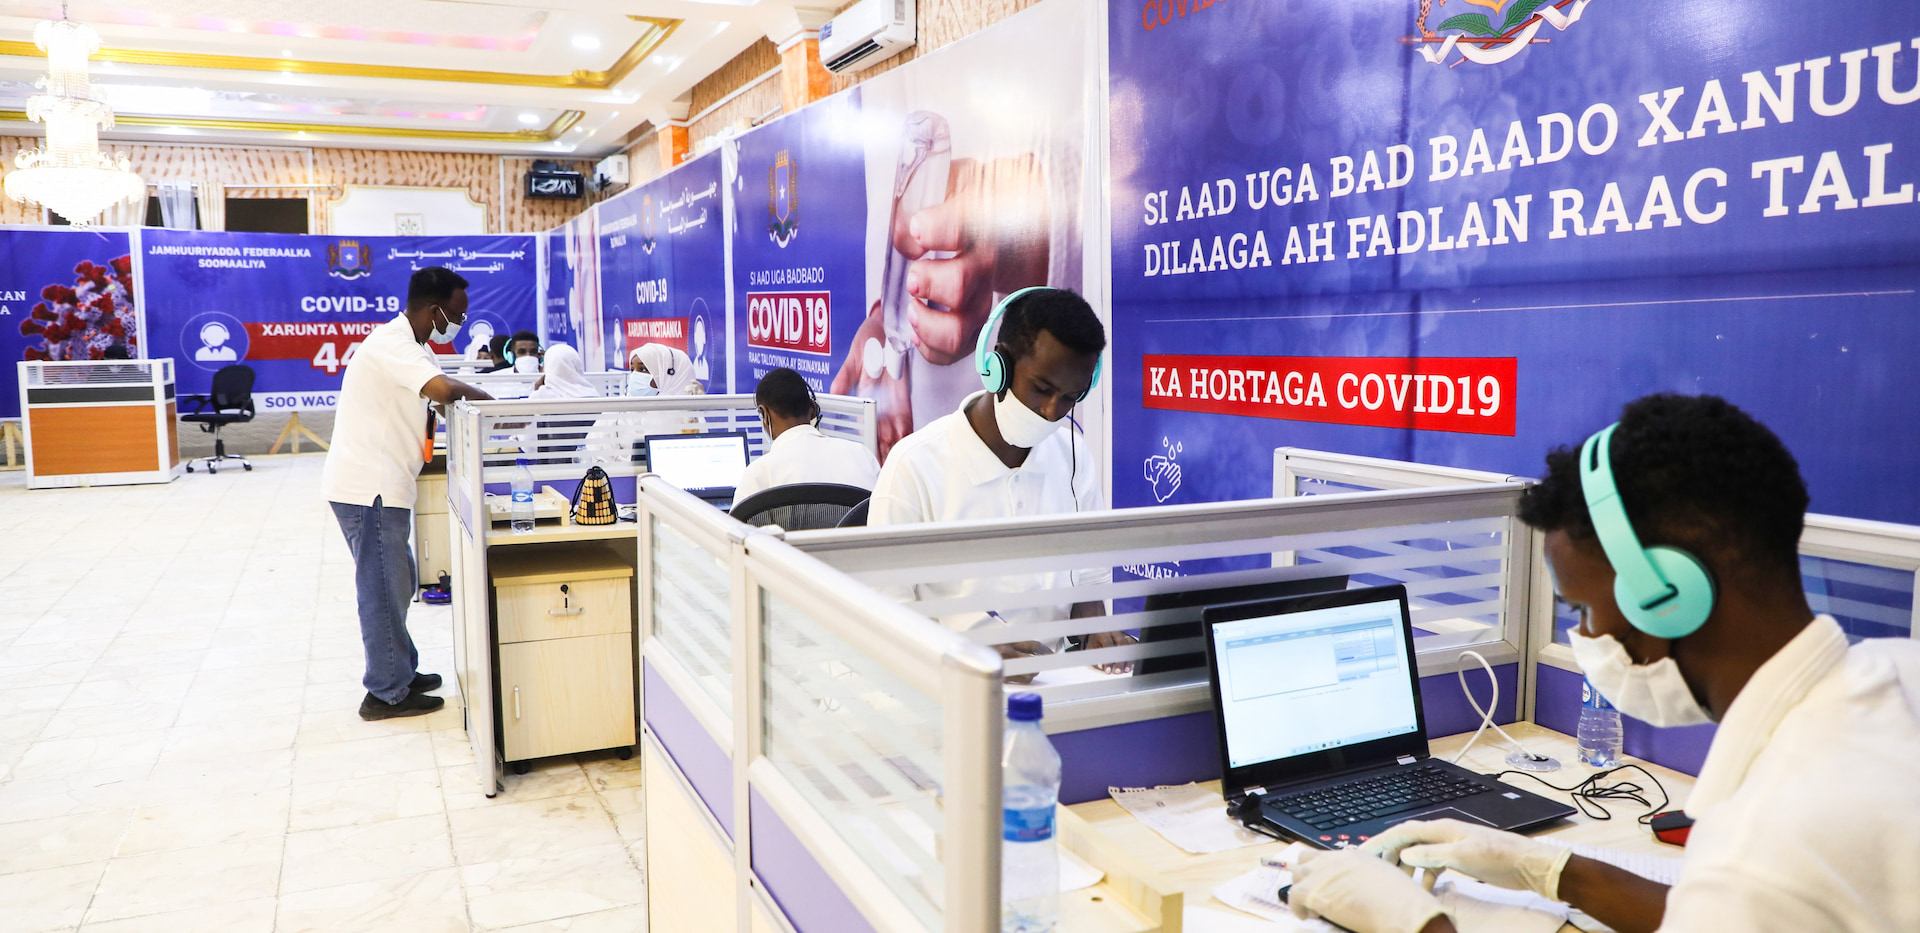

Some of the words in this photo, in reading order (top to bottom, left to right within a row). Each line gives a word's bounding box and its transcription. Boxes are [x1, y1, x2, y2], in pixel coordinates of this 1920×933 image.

[1143, 189, 1169, 226] SI
[1175, 178, 1237, 222] AAD
[1246, 162, 1320, 211] UGA
[1329, 143, 1415, 198] BAD
[1428, 102, 1619, 182] BAADO
[1143, 230, 1273, 277] DILAAGA
[1281, 220, 1336, 265] AH
[1346, 193, 1533, 260] FADLAN
[1548, 167, 1728, 240] RAAC
[149, 245, 241, 257] JAMHUURIYADDA
[243, 247, 311, 258] FEDERAALKA
[198, 258, 266, 269] SOOMAALIYA
[750, 271, 756, 286] SI
[757, 270, 770, 285] AAD
[771, 269, 786, 285] UGA
[786, 266, 825, 284] BADBADO
[636, 278, 667, 304] COVID-19
[301, 295, 400, 313] COVID-19
[262, 323, 338, 336] XARUNTA
[749, 298, 803, 344] COVID
[805, 298, 828, 347] 19
[265, 397, 297, 408] SOO
[301, 396, 336, 407] WAC
[1149, 366, 1183, 398] KA
[1189, 367, 1328, 408] HORTAGA
[1336, 372, 1501, 418] COVID19
